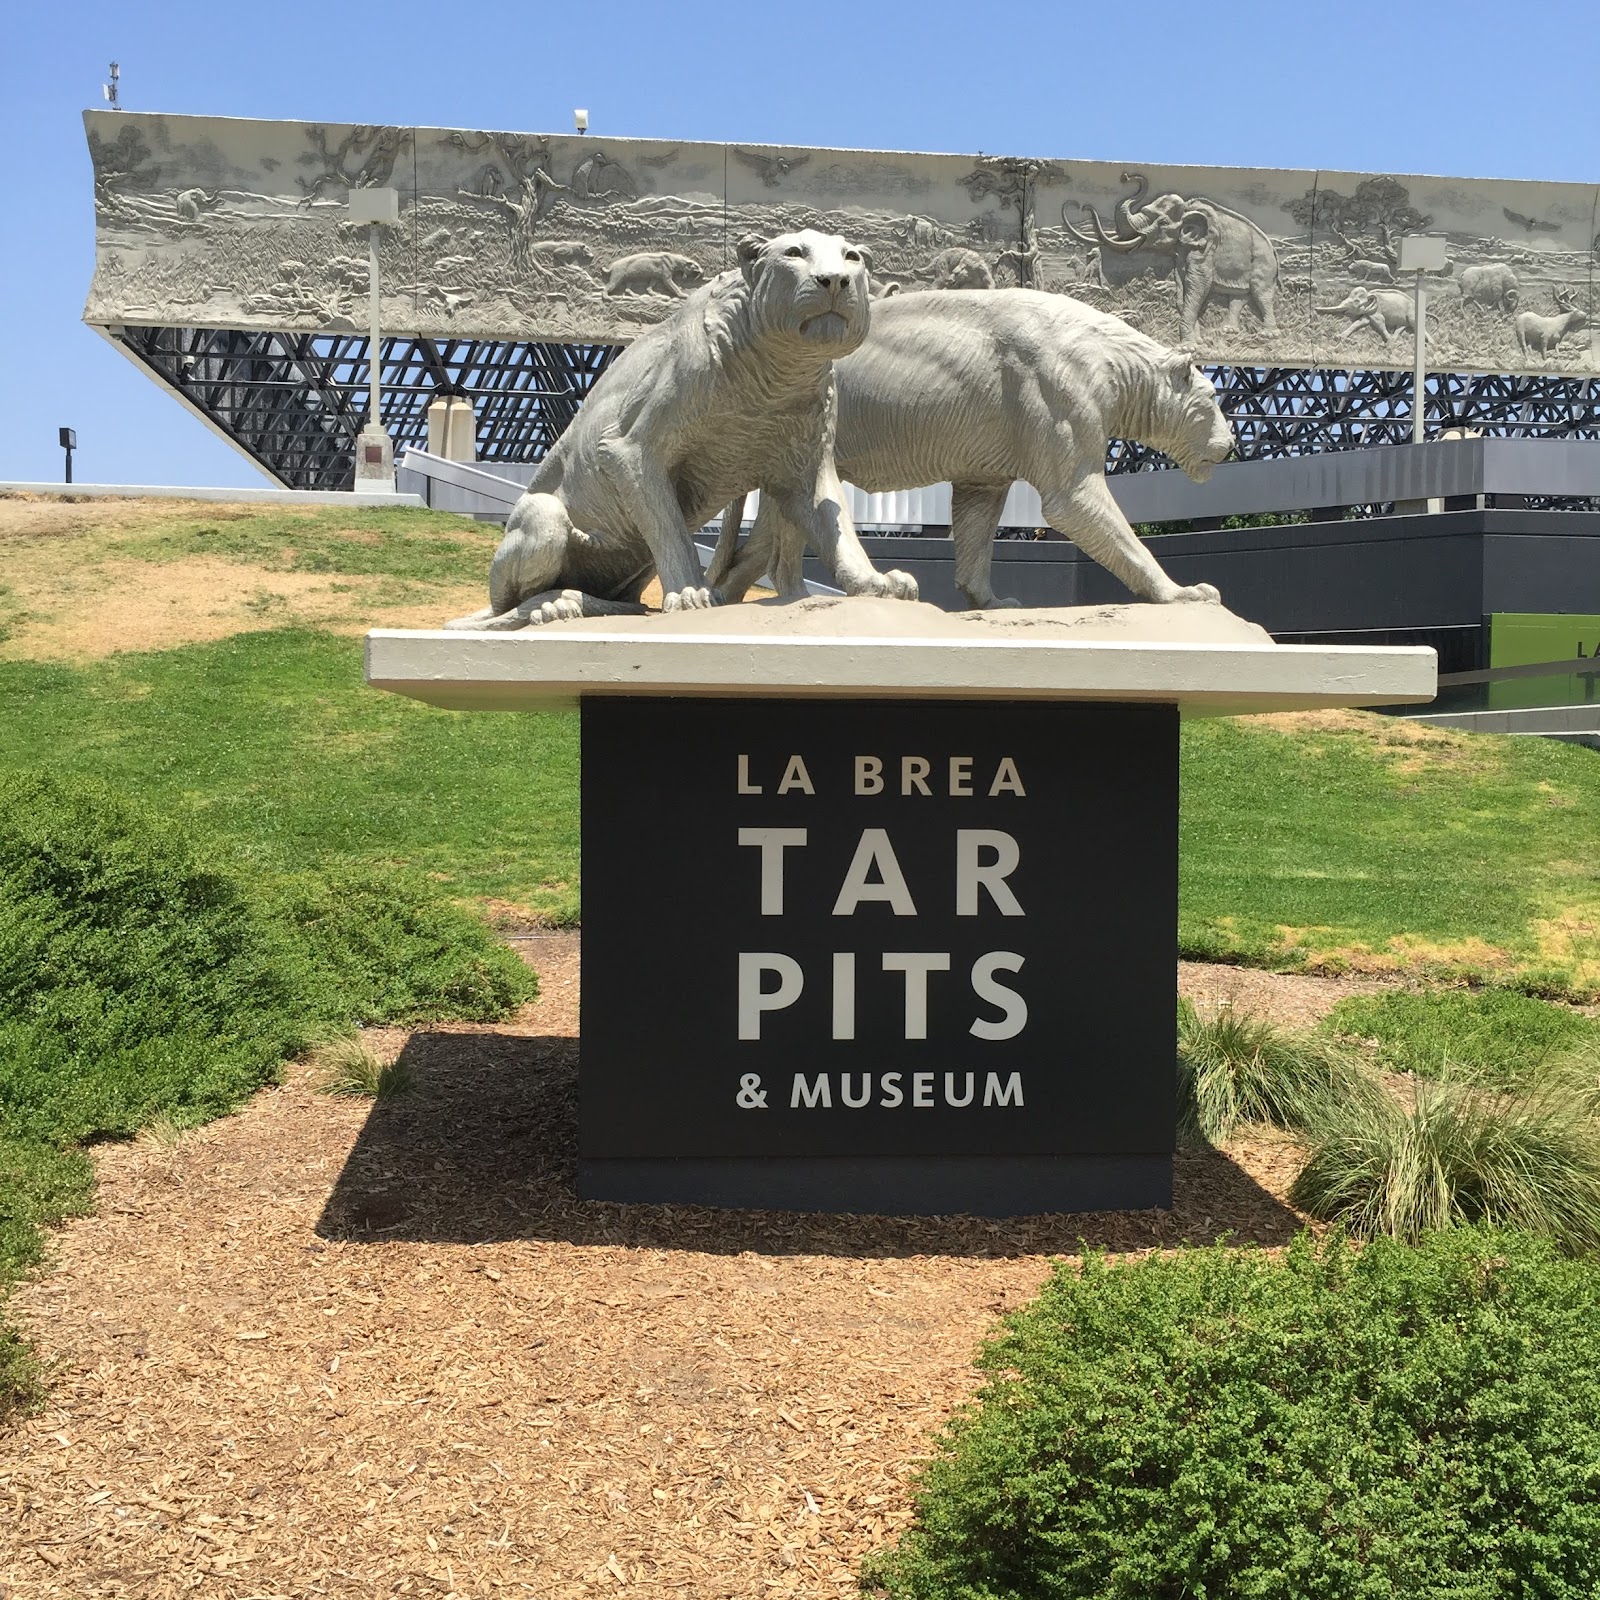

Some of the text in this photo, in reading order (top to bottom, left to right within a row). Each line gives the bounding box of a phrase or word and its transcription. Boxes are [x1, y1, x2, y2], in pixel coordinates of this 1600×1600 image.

[738, 754, 1026, 797] LA BREA
[738, 827, 1026, 917] TAR
[737, 951, 1028, 1041] PITS
[736, 1071, 1026, 1109] & MUSEUM
